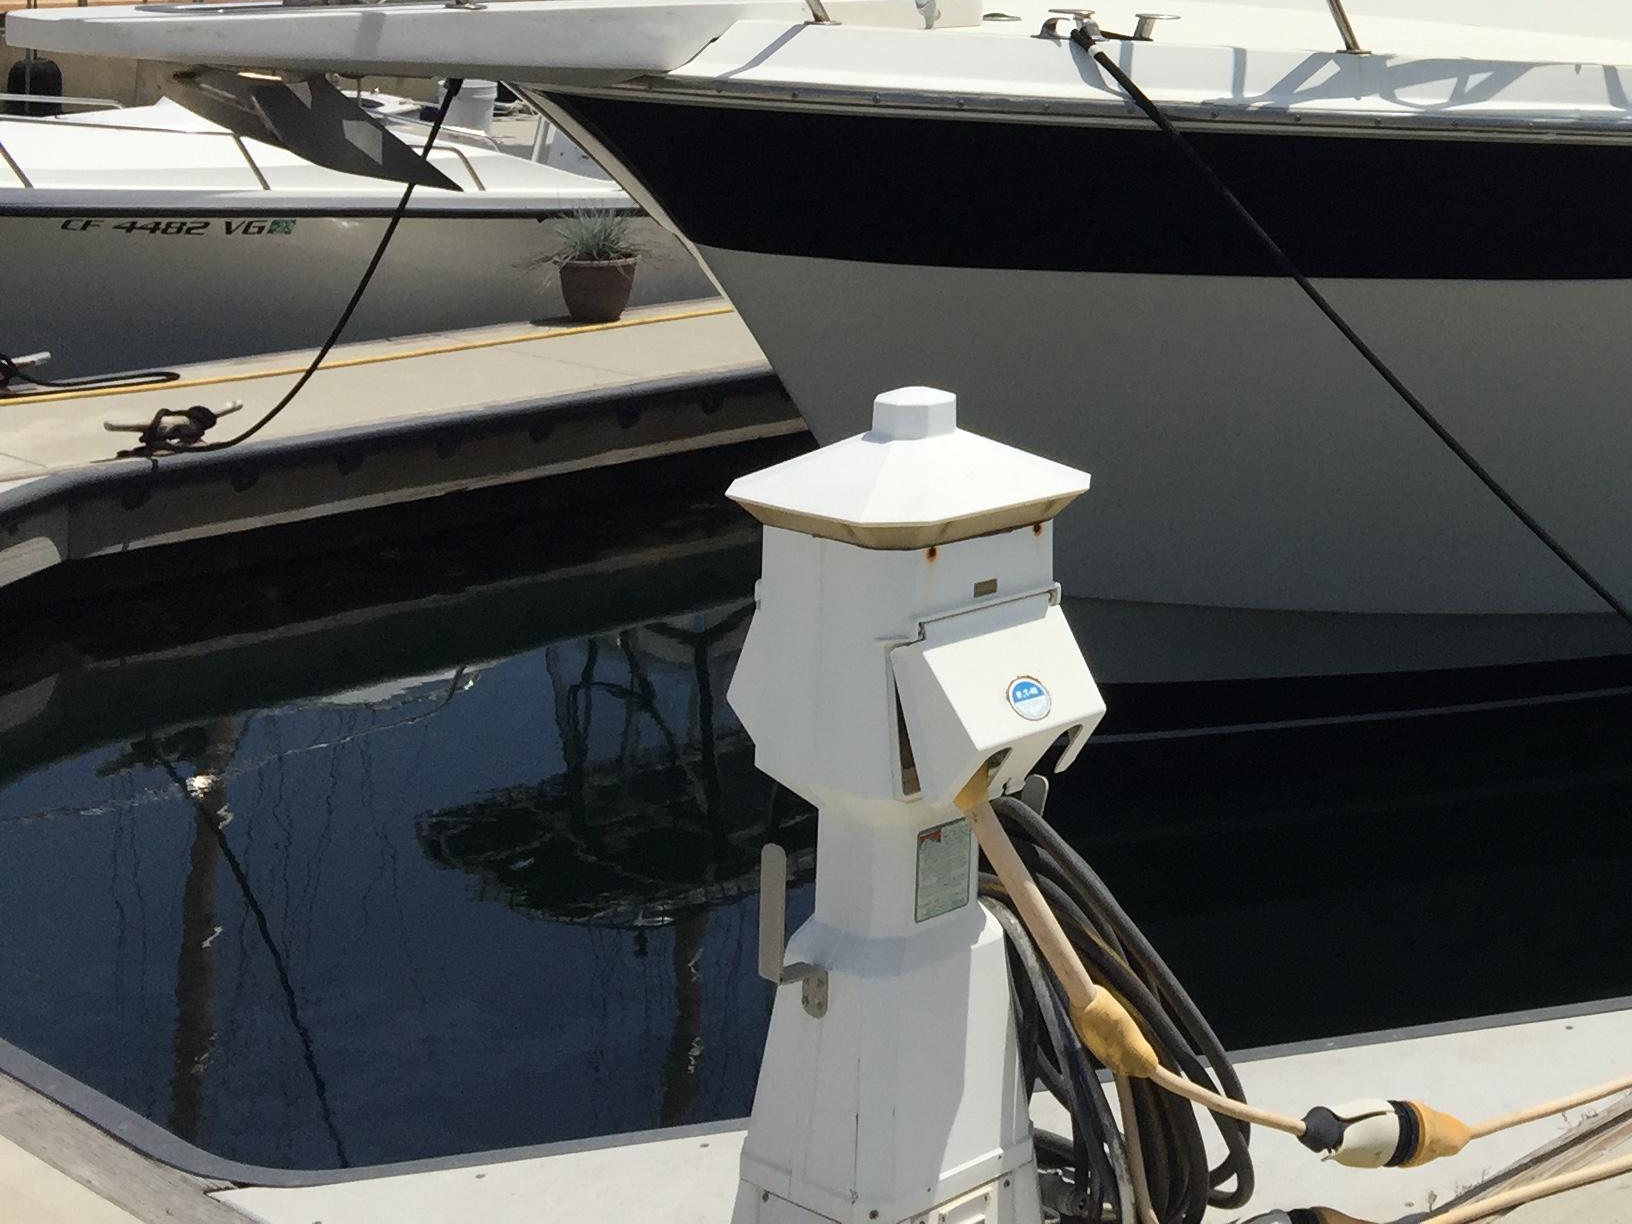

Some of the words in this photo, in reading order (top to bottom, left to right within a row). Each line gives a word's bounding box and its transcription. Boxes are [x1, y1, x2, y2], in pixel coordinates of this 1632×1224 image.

[61, 219, 104, 231] CF
[112, 221, 210, 235] 4482
[225, 221, 267, 235] VG
